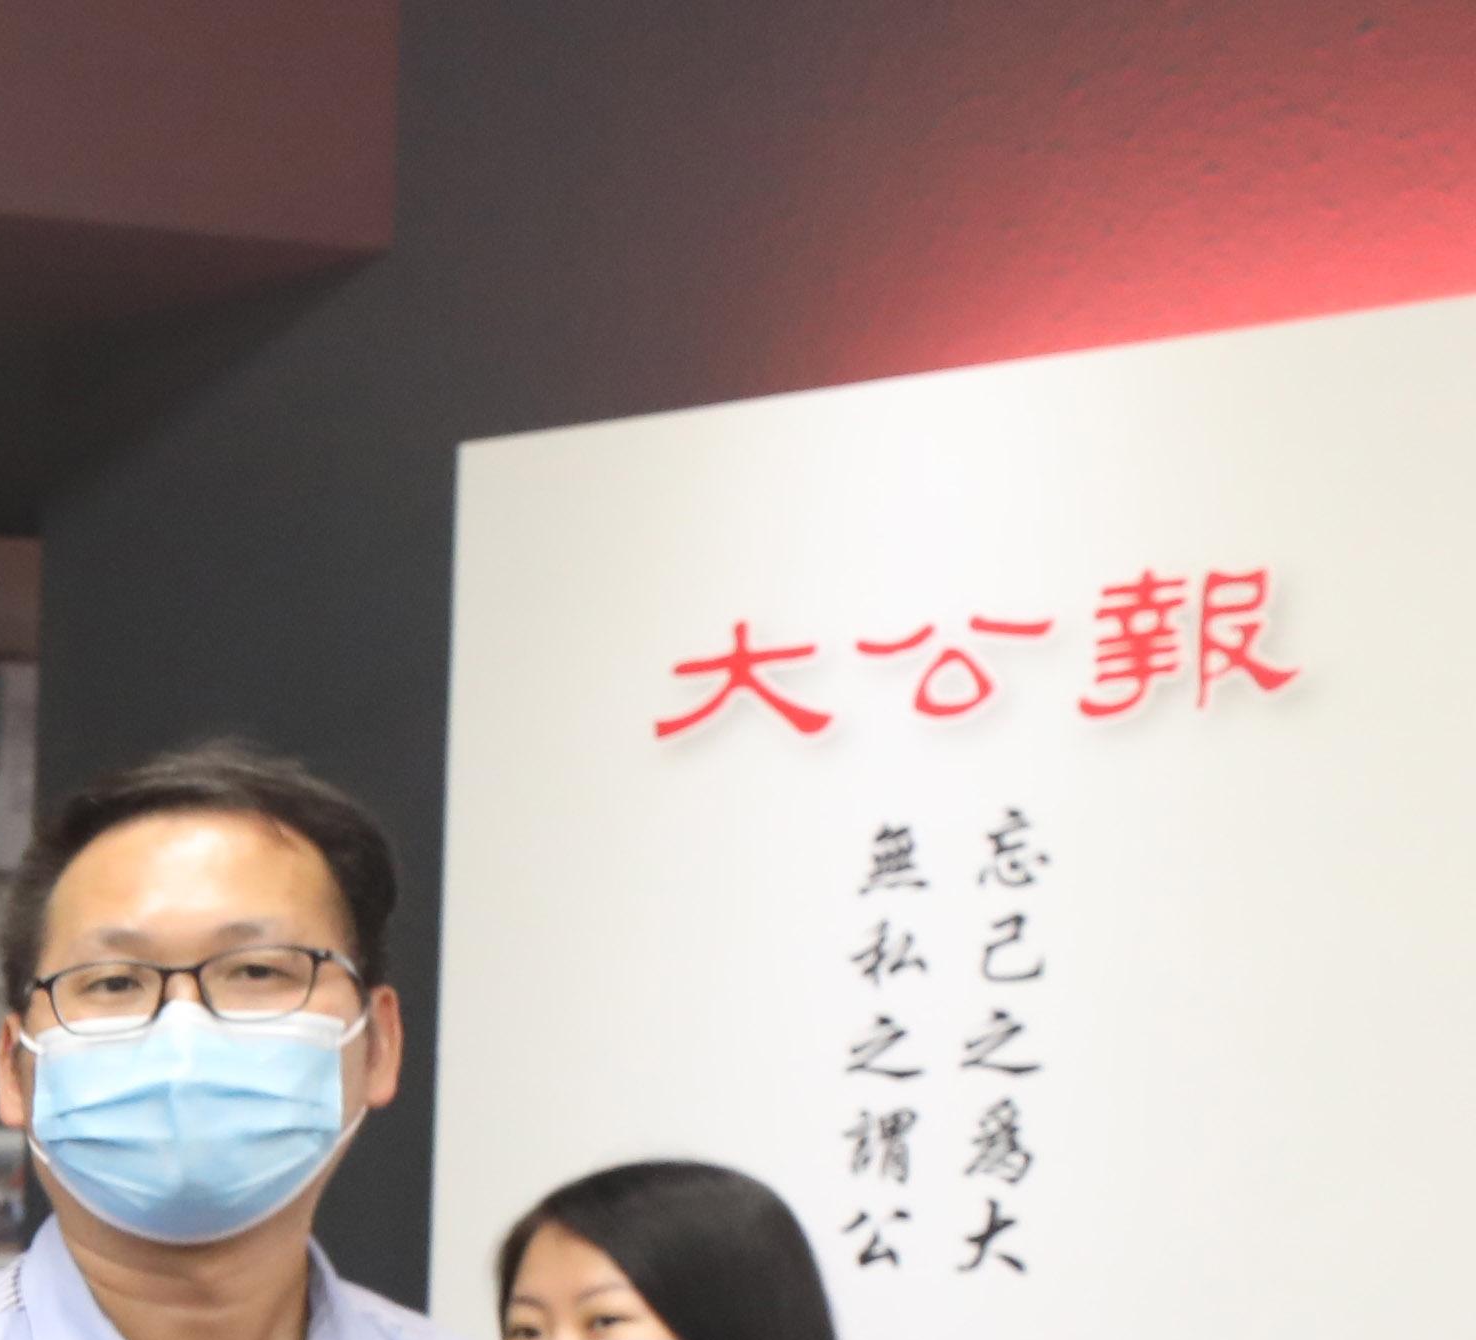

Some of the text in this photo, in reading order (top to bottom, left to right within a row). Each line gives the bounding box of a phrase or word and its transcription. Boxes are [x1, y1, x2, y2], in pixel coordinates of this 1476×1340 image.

[655, 567, 1303, 738] 大公報
[840, 824, 930, 1272] 無私之謂公
